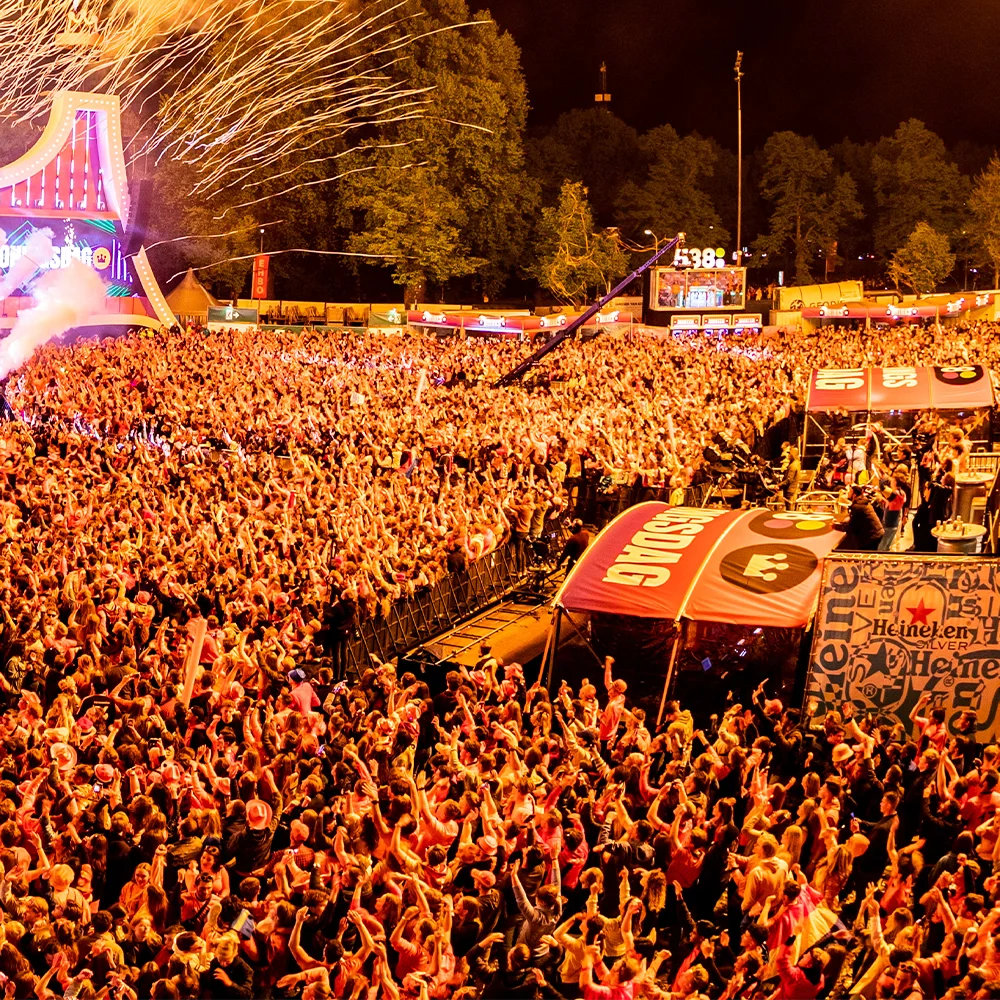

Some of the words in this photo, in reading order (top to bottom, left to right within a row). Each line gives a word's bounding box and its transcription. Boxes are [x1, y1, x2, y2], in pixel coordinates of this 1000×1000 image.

[256, 259, 265, 295] EHBO
[871, 618, 969, 640] Heineken
[916, 640, 969, 651] SILVER
